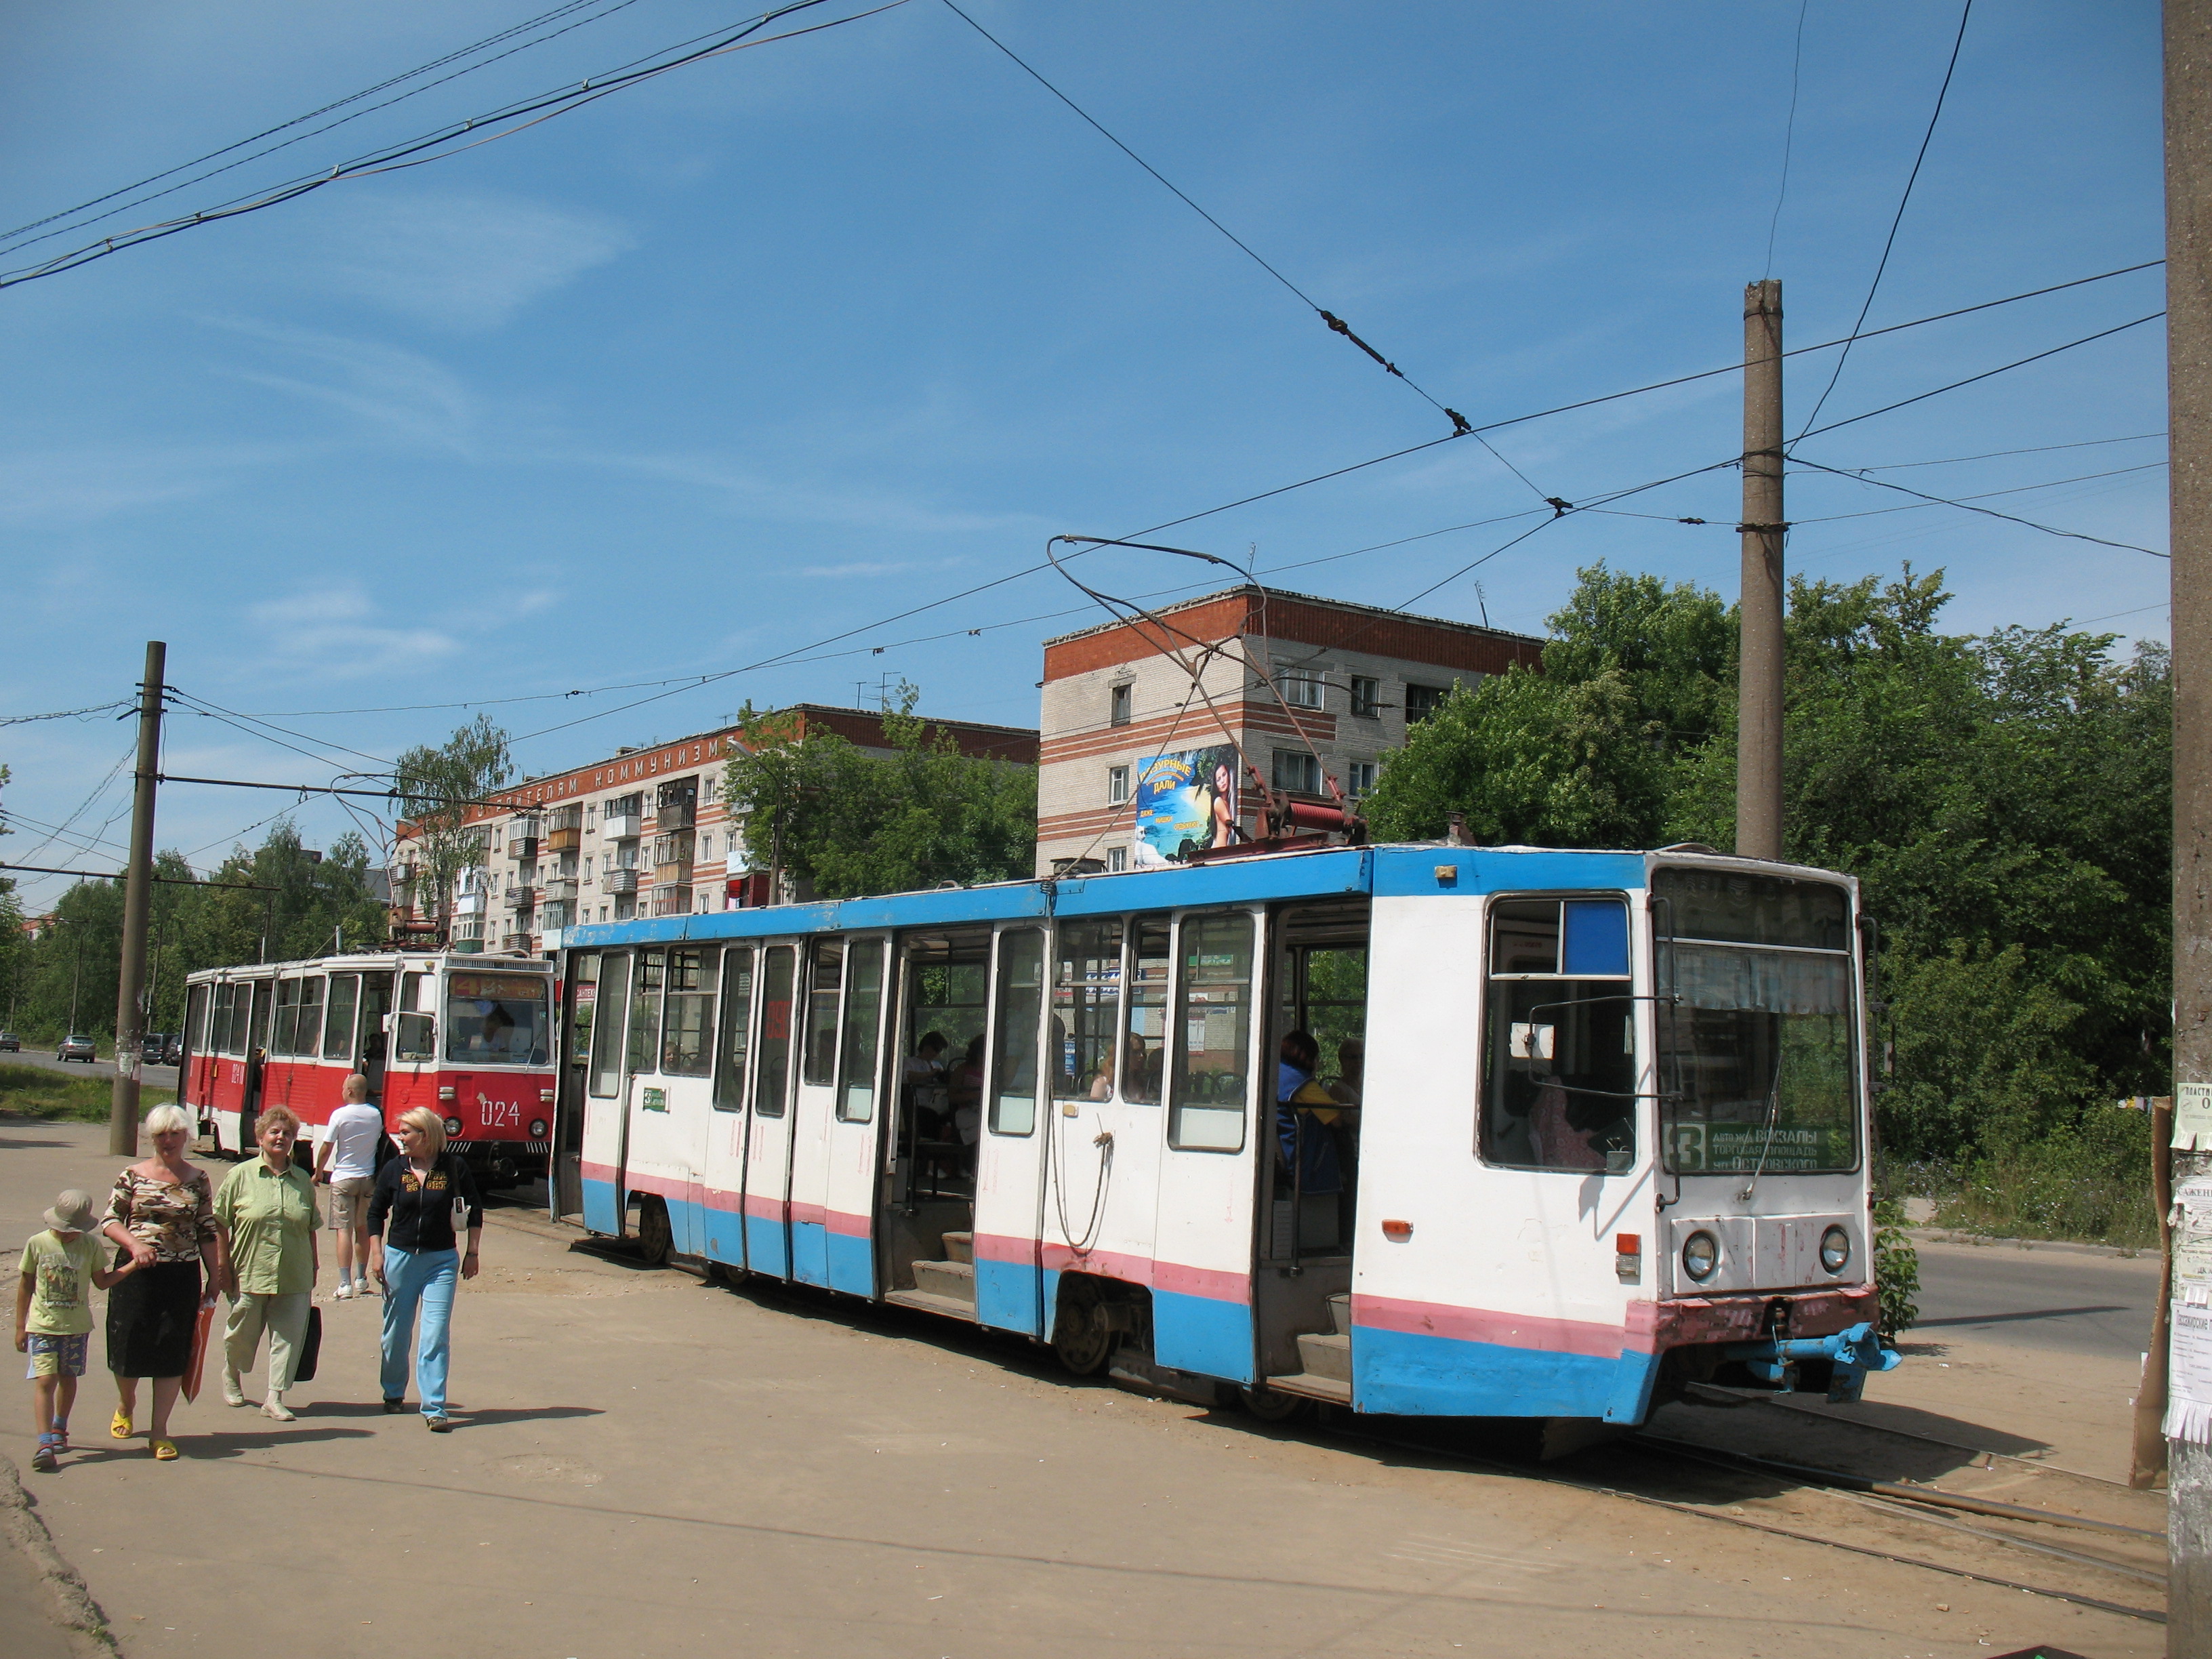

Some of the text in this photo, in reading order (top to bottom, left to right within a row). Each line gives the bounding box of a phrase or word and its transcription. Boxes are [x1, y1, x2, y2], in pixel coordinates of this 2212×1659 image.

[478, 777, 577, 817] СРОИТЕЛЯМ
[1153, 779, 1176, 795] ДАЛИ
[482, 1101, 520, 1127] 024
